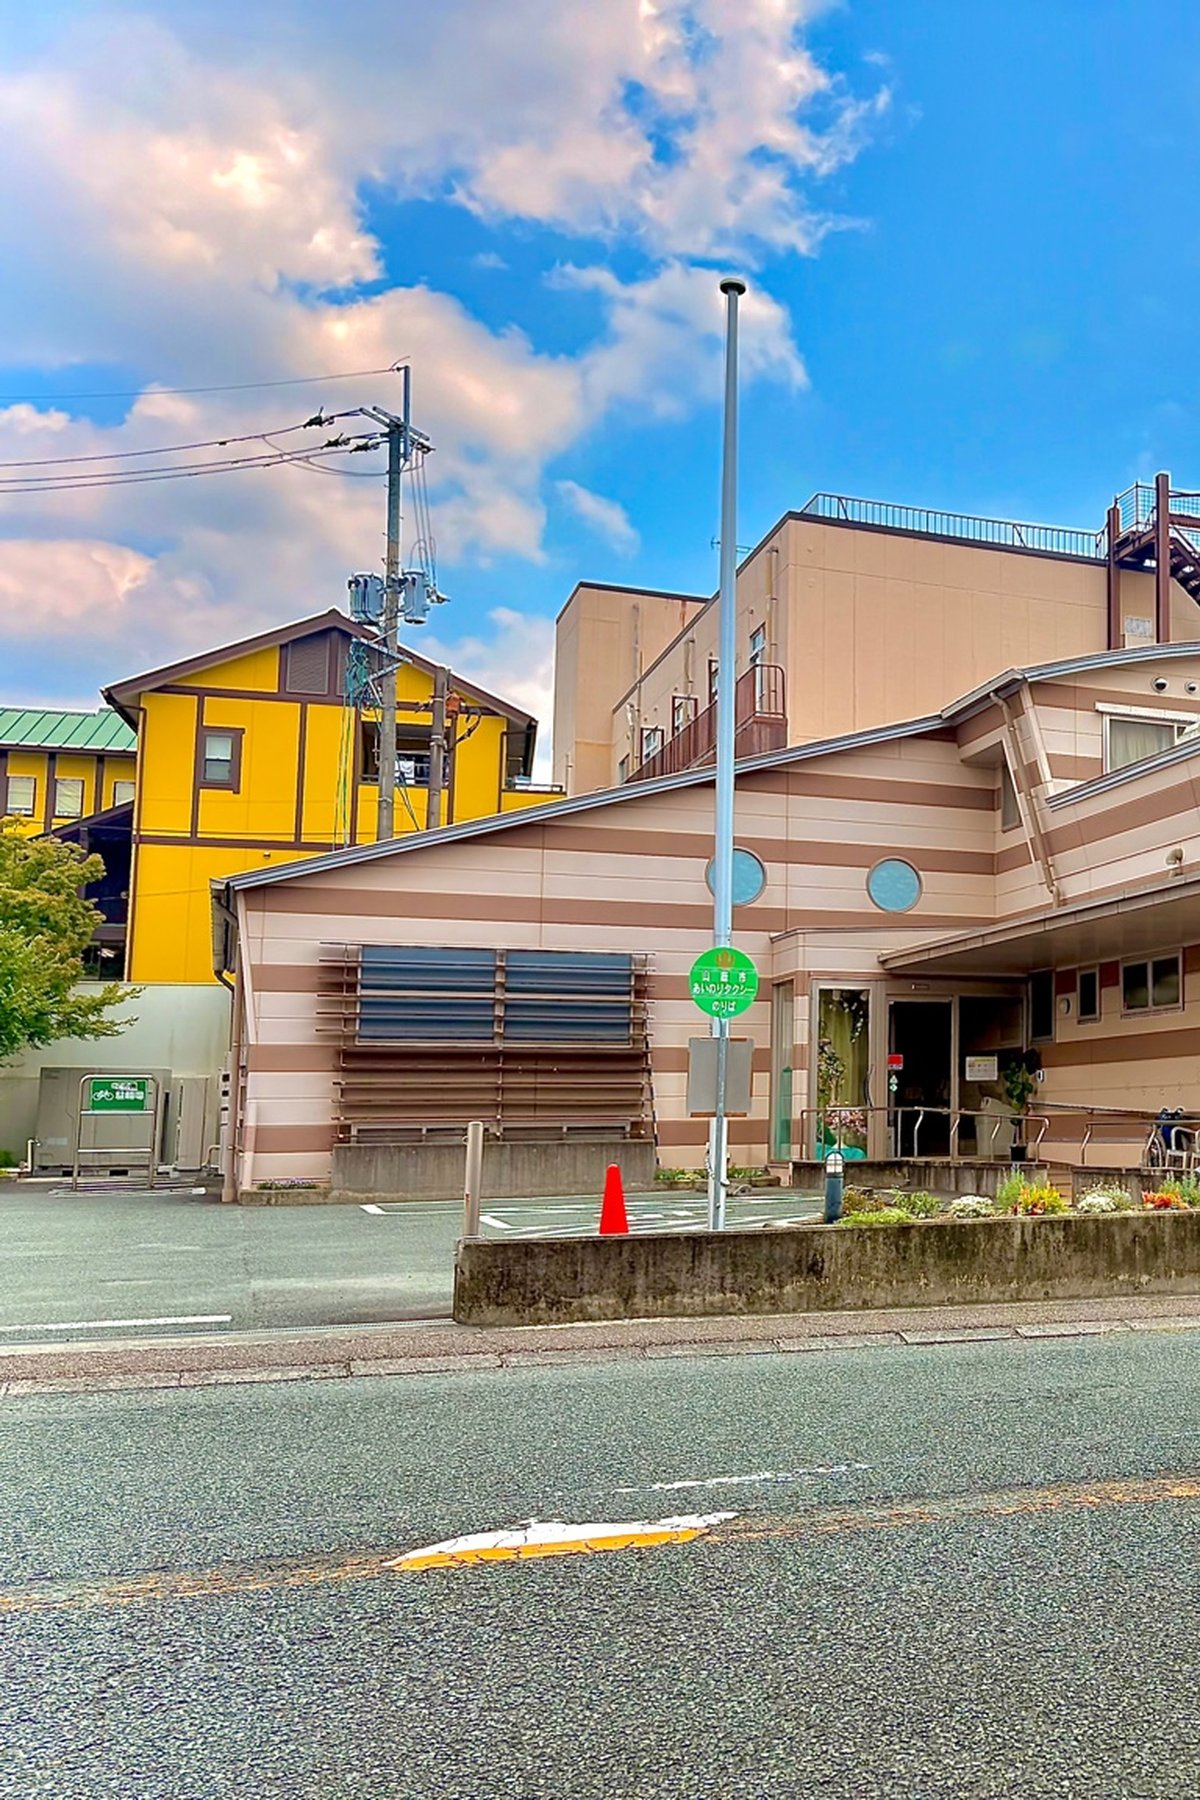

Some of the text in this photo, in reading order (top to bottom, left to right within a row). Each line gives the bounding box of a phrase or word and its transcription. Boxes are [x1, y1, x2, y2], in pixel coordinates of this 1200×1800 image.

[693, 983, 755, 996] あいのりタクシー
[712, 1001, 736, 1012] のりば
